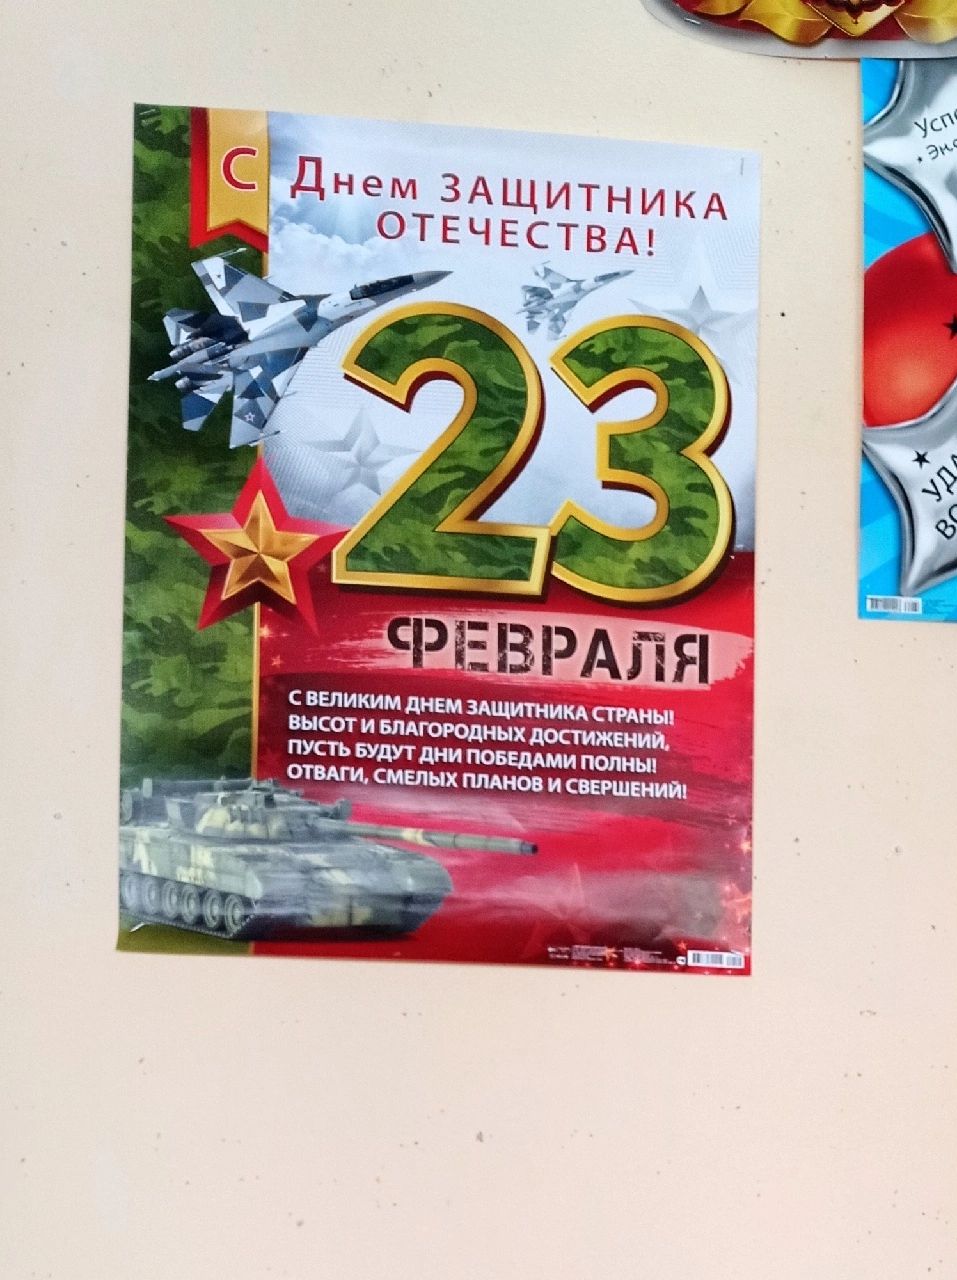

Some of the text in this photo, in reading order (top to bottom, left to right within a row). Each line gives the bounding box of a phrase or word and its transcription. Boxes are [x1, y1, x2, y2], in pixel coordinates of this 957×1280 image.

[222, 147, 729, 221] С Днем ЗАЩИТНИКА
[377, 209, 655, 257] ОТЕЧЕСТВА!
[332, 302, 734, 604] 23
[387, 616, 710, 684] ФЕВРАЛЯ
[288, 689, 675, 726] С ВЕЛИКИМ ДНЕМ ЗАЩИТНИКА СТРАНЫ!
[288, 714, 670, 753] ВЫСОТ И БЛАГОРОДНЫХ ДОСТИЖЕНИЙ,
[288, 739, 657, 774] ПУСТЬ БУДУТ ДНИ ПОБЕДАМИ ПОЛНЫ!
[286, 763, 688, 800] ОТВАГИ, СМЕЛЫХ ПЛАНОВ И СВЕРШЕНИЙ!
